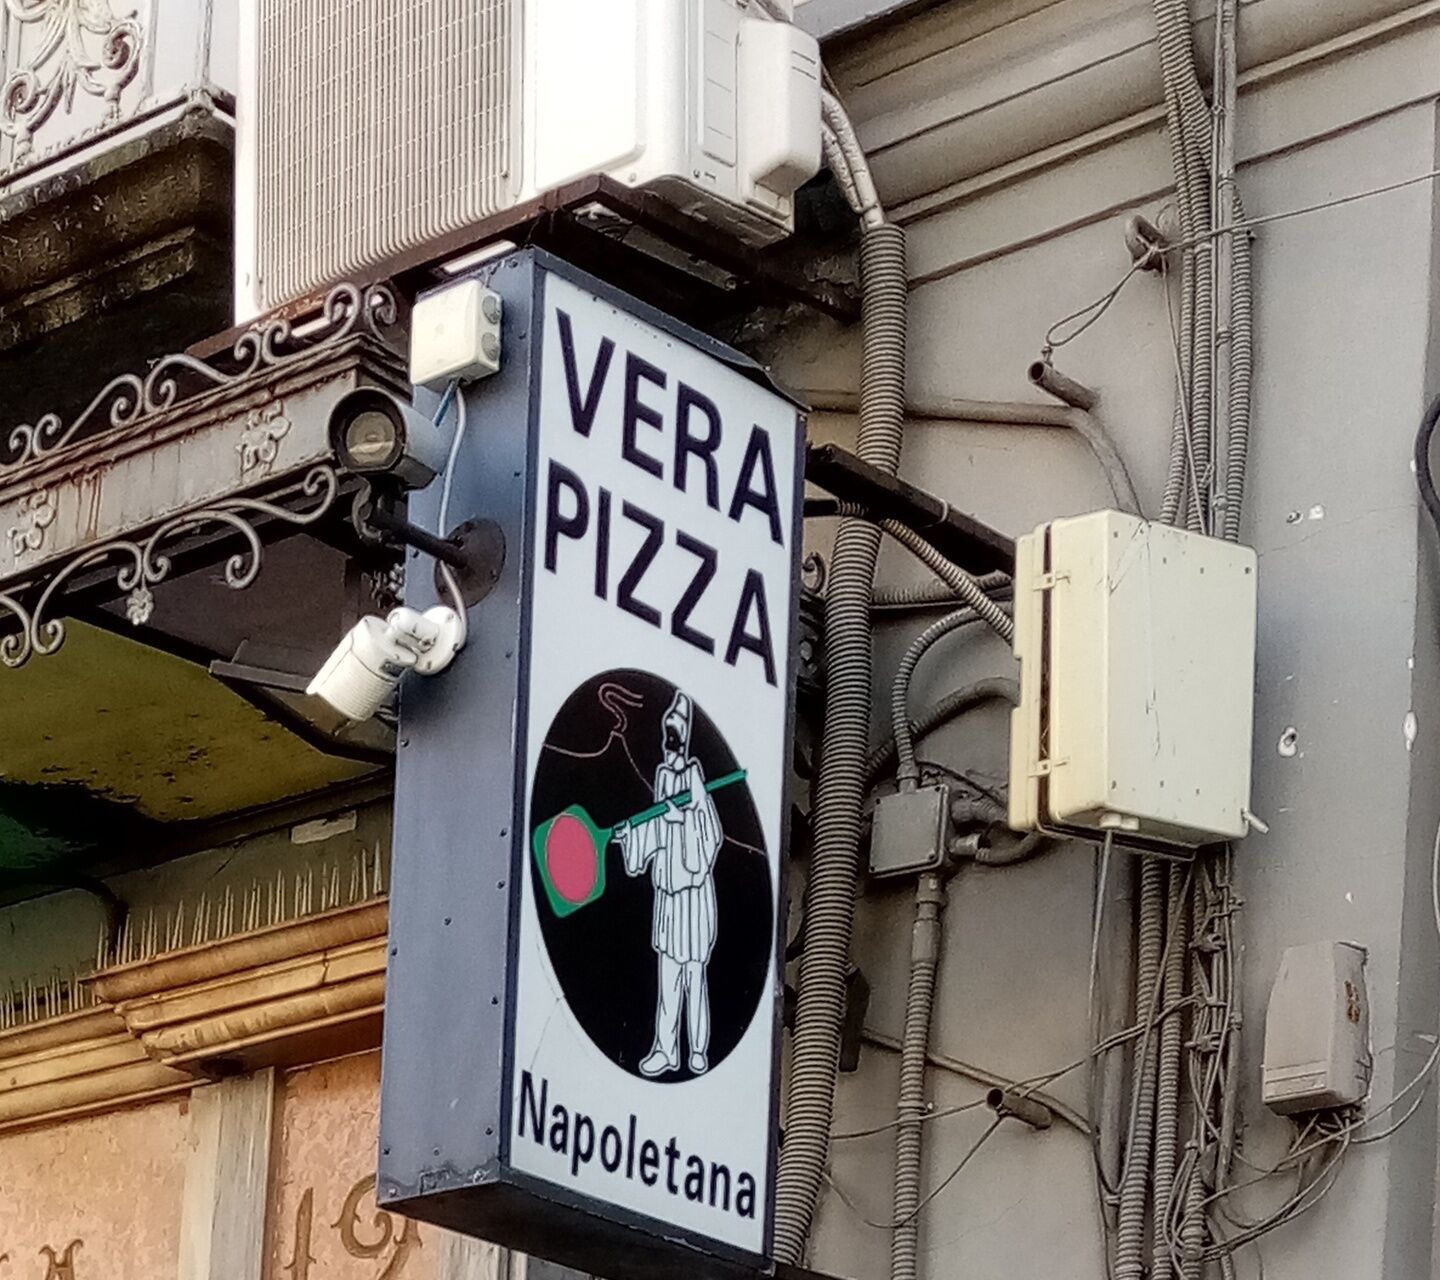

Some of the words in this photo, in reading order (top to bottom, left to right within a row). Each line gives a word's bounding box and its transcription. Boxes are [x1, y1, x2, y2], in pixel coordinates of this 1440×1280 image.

[555, 307, 784, 549] VERA
[544, 457, 778, 688] PIZZA
[517, 1068, 757, 1220] Napoletana
